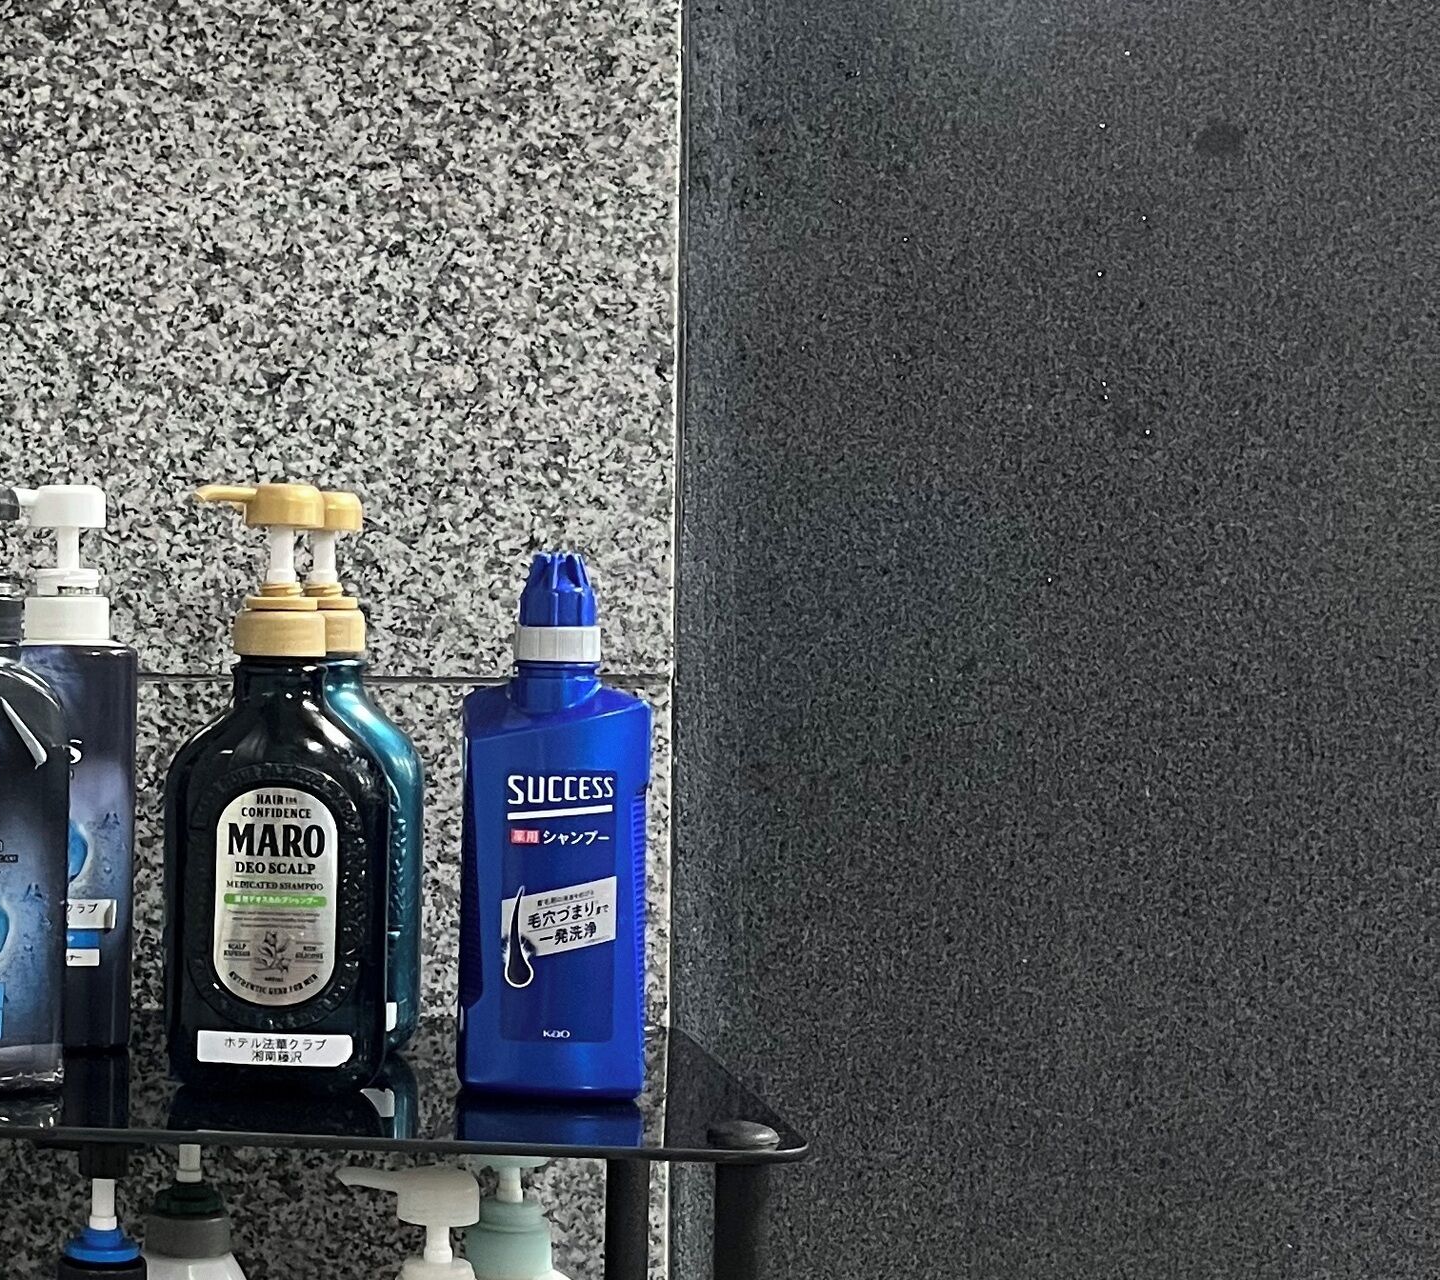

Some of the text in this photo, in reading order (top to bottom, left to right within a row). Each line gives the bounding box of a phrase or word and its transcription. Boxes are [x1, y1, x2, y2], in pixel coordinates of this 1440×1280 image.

[507, 774, 614, 805] SUCCESS
[256, 794, 284, 805] HAIR
[241, 807, 312, 819] CONFIDENCE
[227, 822, 326, 859] MARO
[542, 829, 610, 846] シャンプー
[235, 861, 316, 875] DEO SCALP
[226, 880, 324, 891] MEDICATED SHAMPOO
[539, 921, 598, 946] 一発洗浄
[224, 1038, 328, 1051] ホテル法華クラブ
